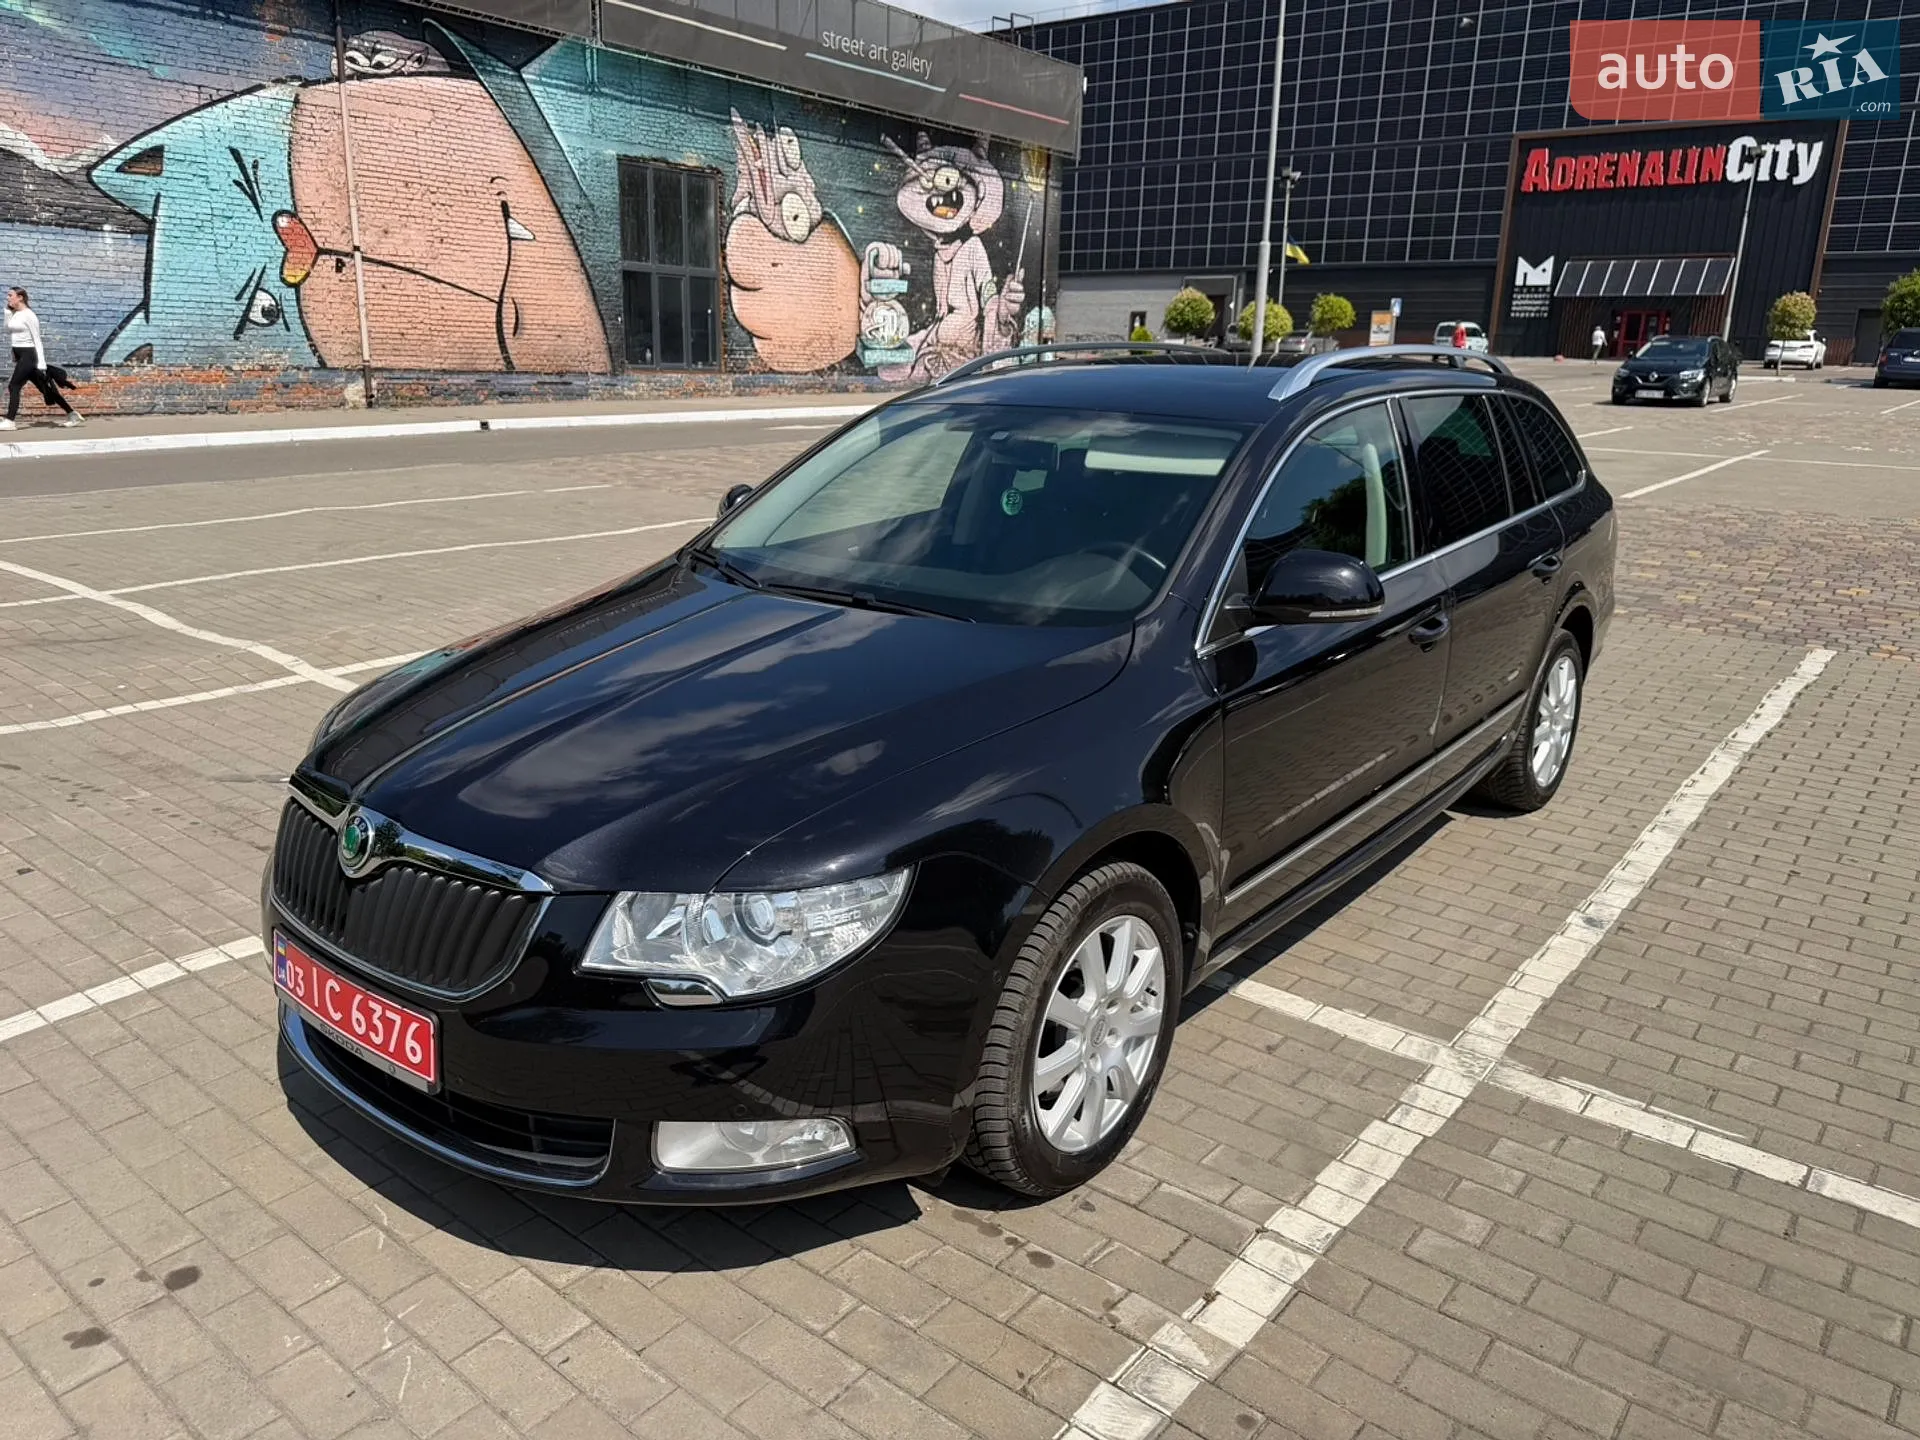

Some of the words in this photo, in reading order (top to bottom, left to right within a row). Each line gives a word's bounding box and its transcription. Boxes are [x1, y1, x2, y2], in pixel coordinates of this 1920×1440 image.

[822, 31, 865, 57] street
[868, 43, 889, 64] art
[891, 50, 932, 80] gallery
[287, 960, 305, 998] 03
[351, 994, 423, 1065] 6376
